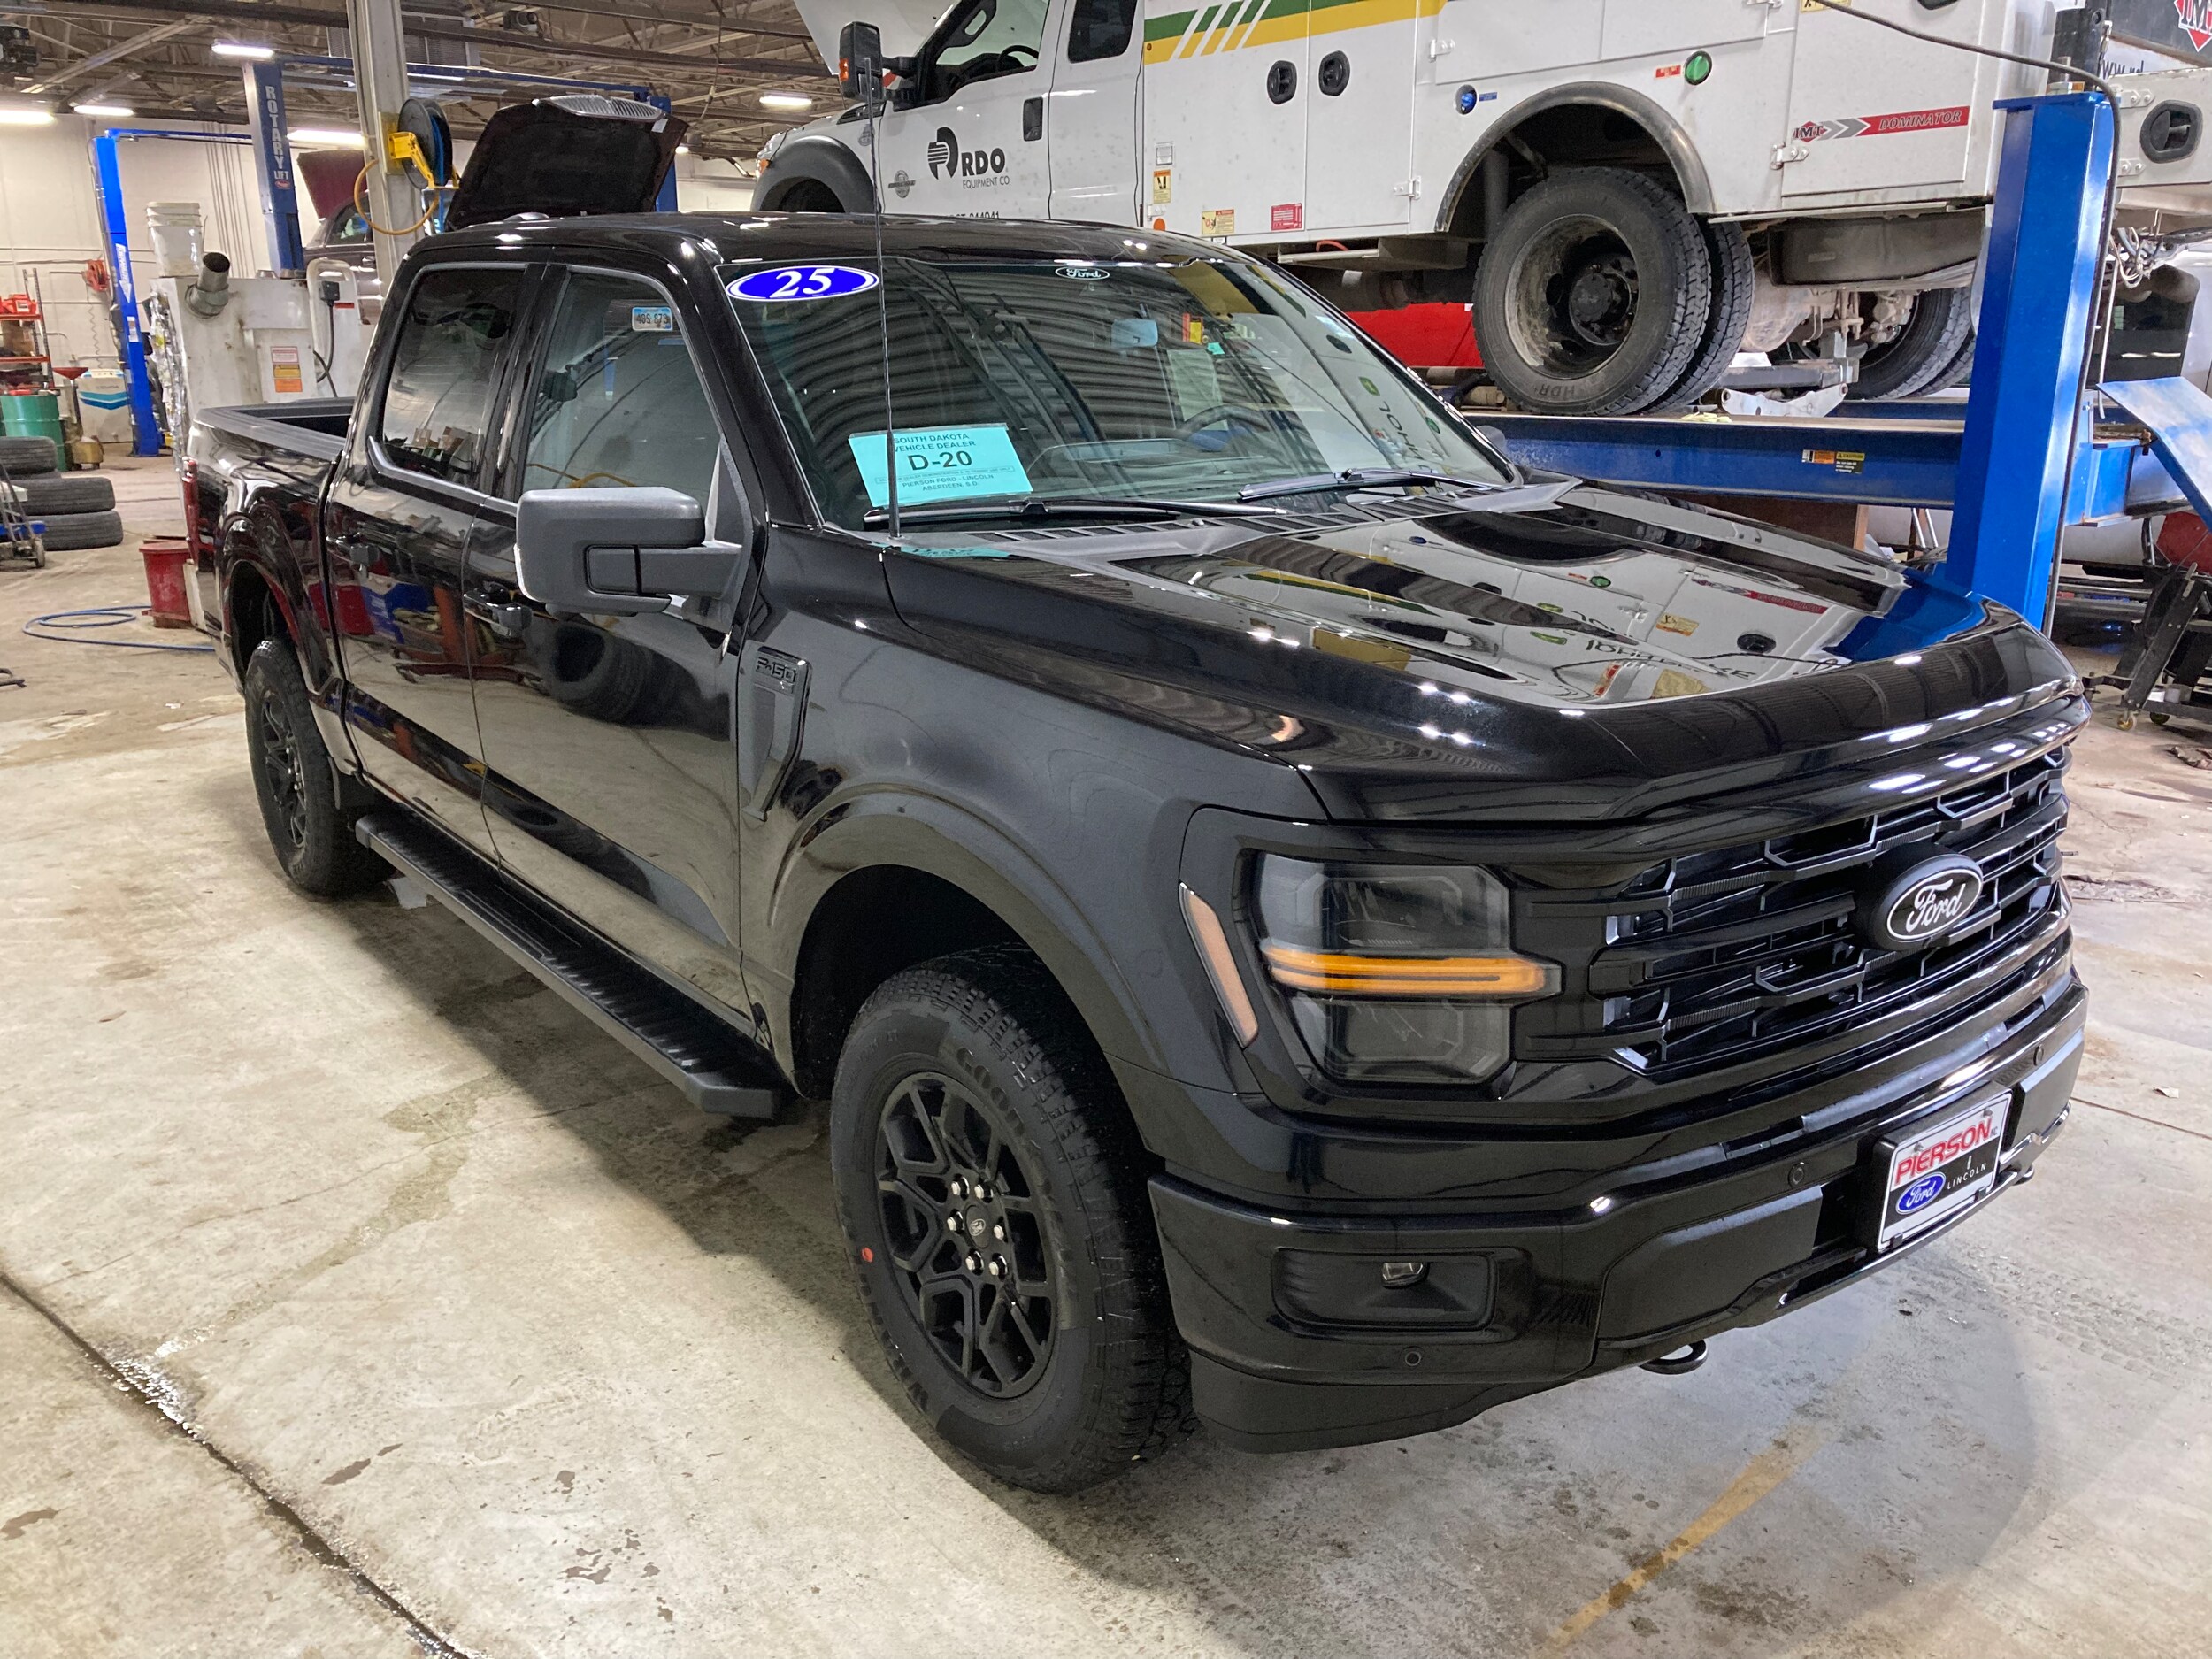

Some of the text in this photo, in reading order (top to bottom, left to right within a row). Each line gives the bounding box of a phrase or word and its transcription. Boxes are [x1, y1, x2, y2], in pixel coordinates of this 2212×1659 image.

[265, 85, 285, 170] ROTARY
[1793, 111, 1962, 140] IMT DOMINATOR
[273, 170, 289, 180] LIFT
[961, 147, 1005, 176] RDO
[963, 176, 998, 189] EQUIPMENT
[769, 267, 835, 299] 25
[1065, 268, 1102, 278] Ford
[893, 433, 970, 444] SOUTH DAKOTA
[893, 440, 976, 452] VEHICLE DEALER
[908, 450, 972, 471] D-20
[902, 479, 935, 488] PIERSON
[756, 657, 797, 683] F-150
[1905, 879, 1966, 933] Ford
[1894, 1117, 1993, 1186] PIERSON
[1947, 1162, 1987, 1190] LINCOLN
[1905, 1179, 1937, 1208] Ford
